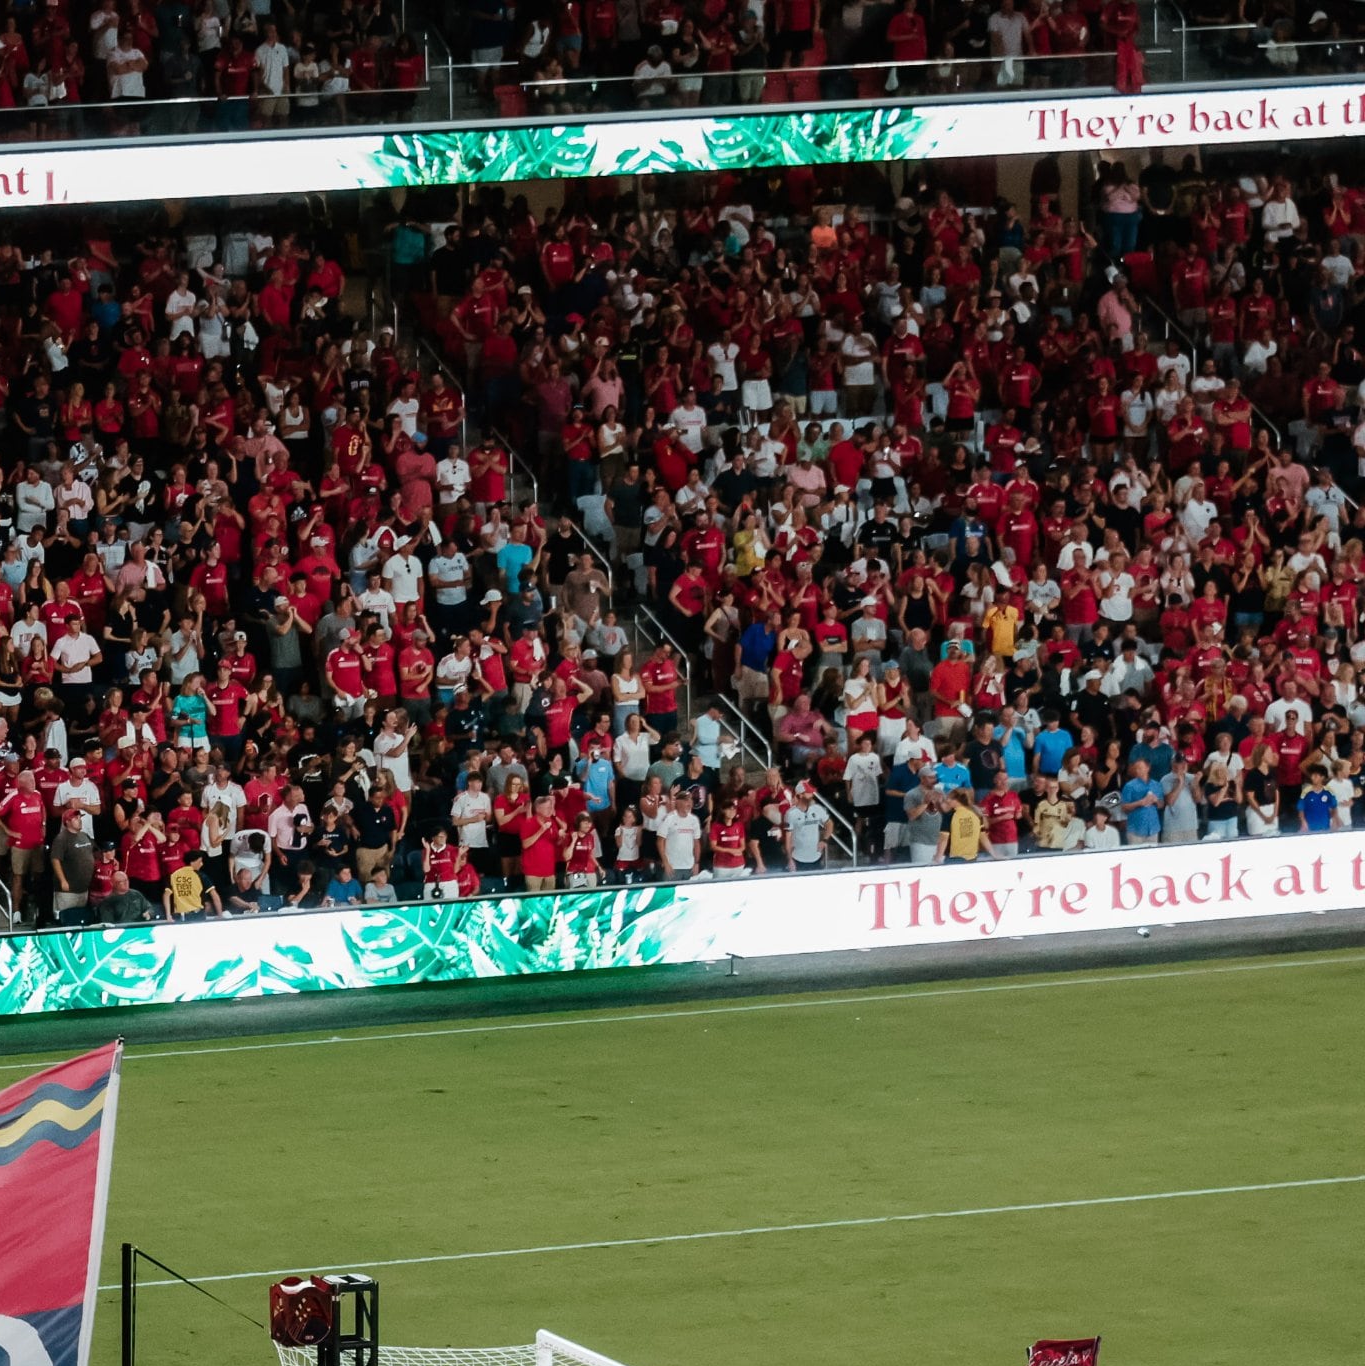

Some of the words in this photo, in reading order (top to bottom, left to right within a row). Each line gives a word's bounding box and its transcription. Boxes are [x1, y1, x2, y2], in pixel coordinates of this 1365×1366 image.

[1028, 104, 1174, 147] They're
[1188, 98, 1279, 132] back
[1292, 98, 1330, 128] at
[1341, 93, 1365, 125] t
[858, 870, 1089, 936] They're
[1110, 853, 1253, 911] back
[1273, 855, 1329, 898] at
